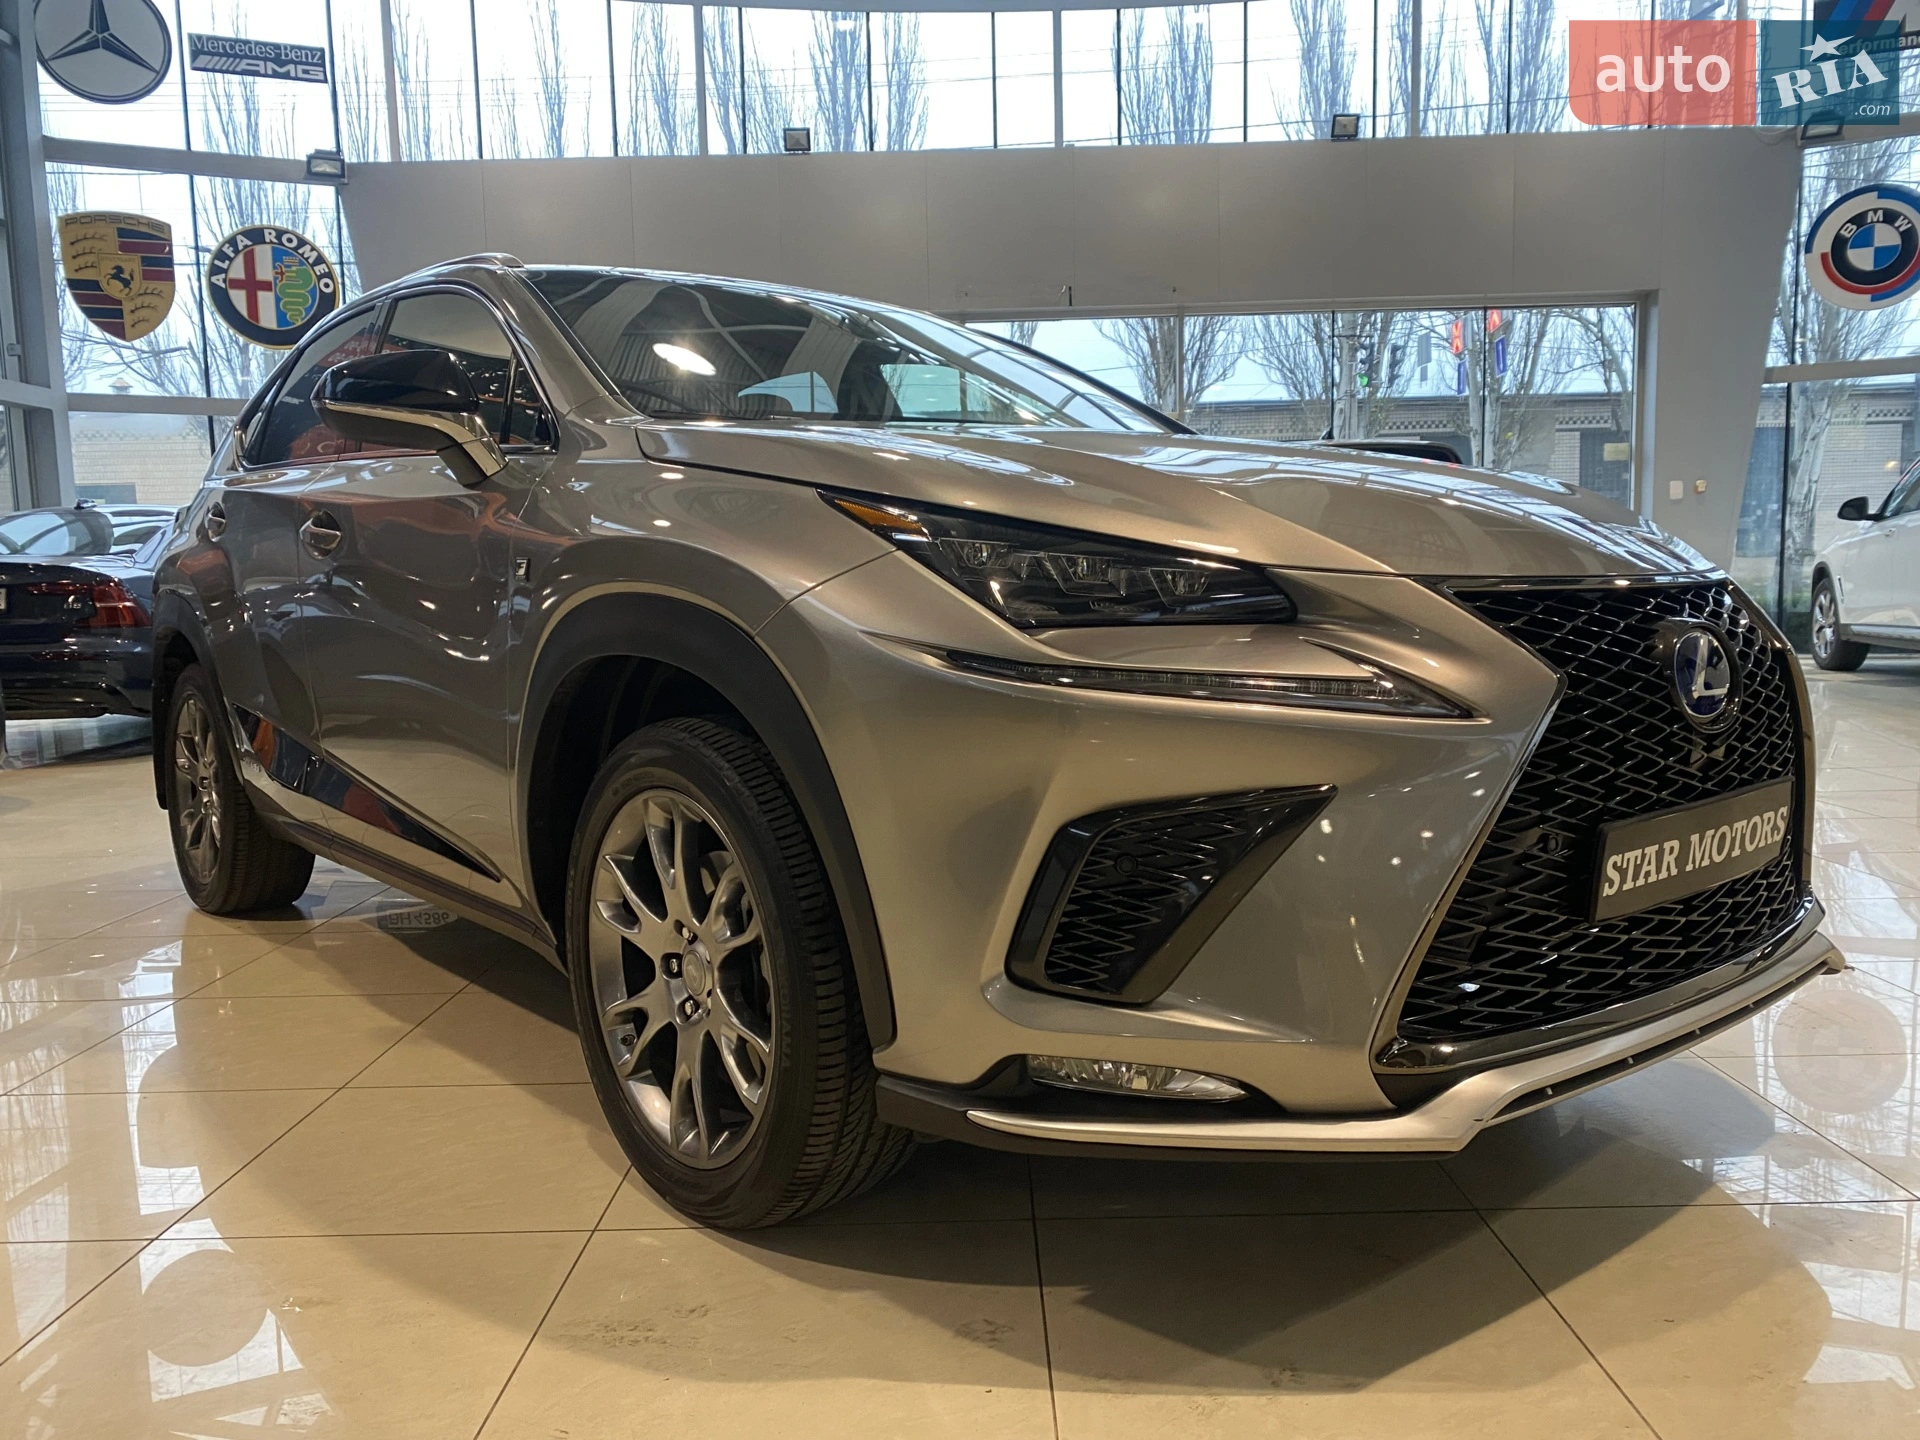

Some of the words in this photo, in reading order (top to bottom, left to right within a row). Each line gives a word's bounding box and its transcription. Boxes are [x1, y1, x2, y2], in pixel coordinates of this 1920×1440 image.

[191, 34, 322, 63] Mercedes-Benz
[235, 59, 325, 80] AMG
[64, 214, 165, 234] PORSCHE
[1840, 209, 1912, 238] BMW
[210, 234, 253, 289] ALFA
[263, 228, 335, 294] ROMEO
[1602, 839, 1680, 897] STAR
[1685, 805, 1788, 872] MOTORS
